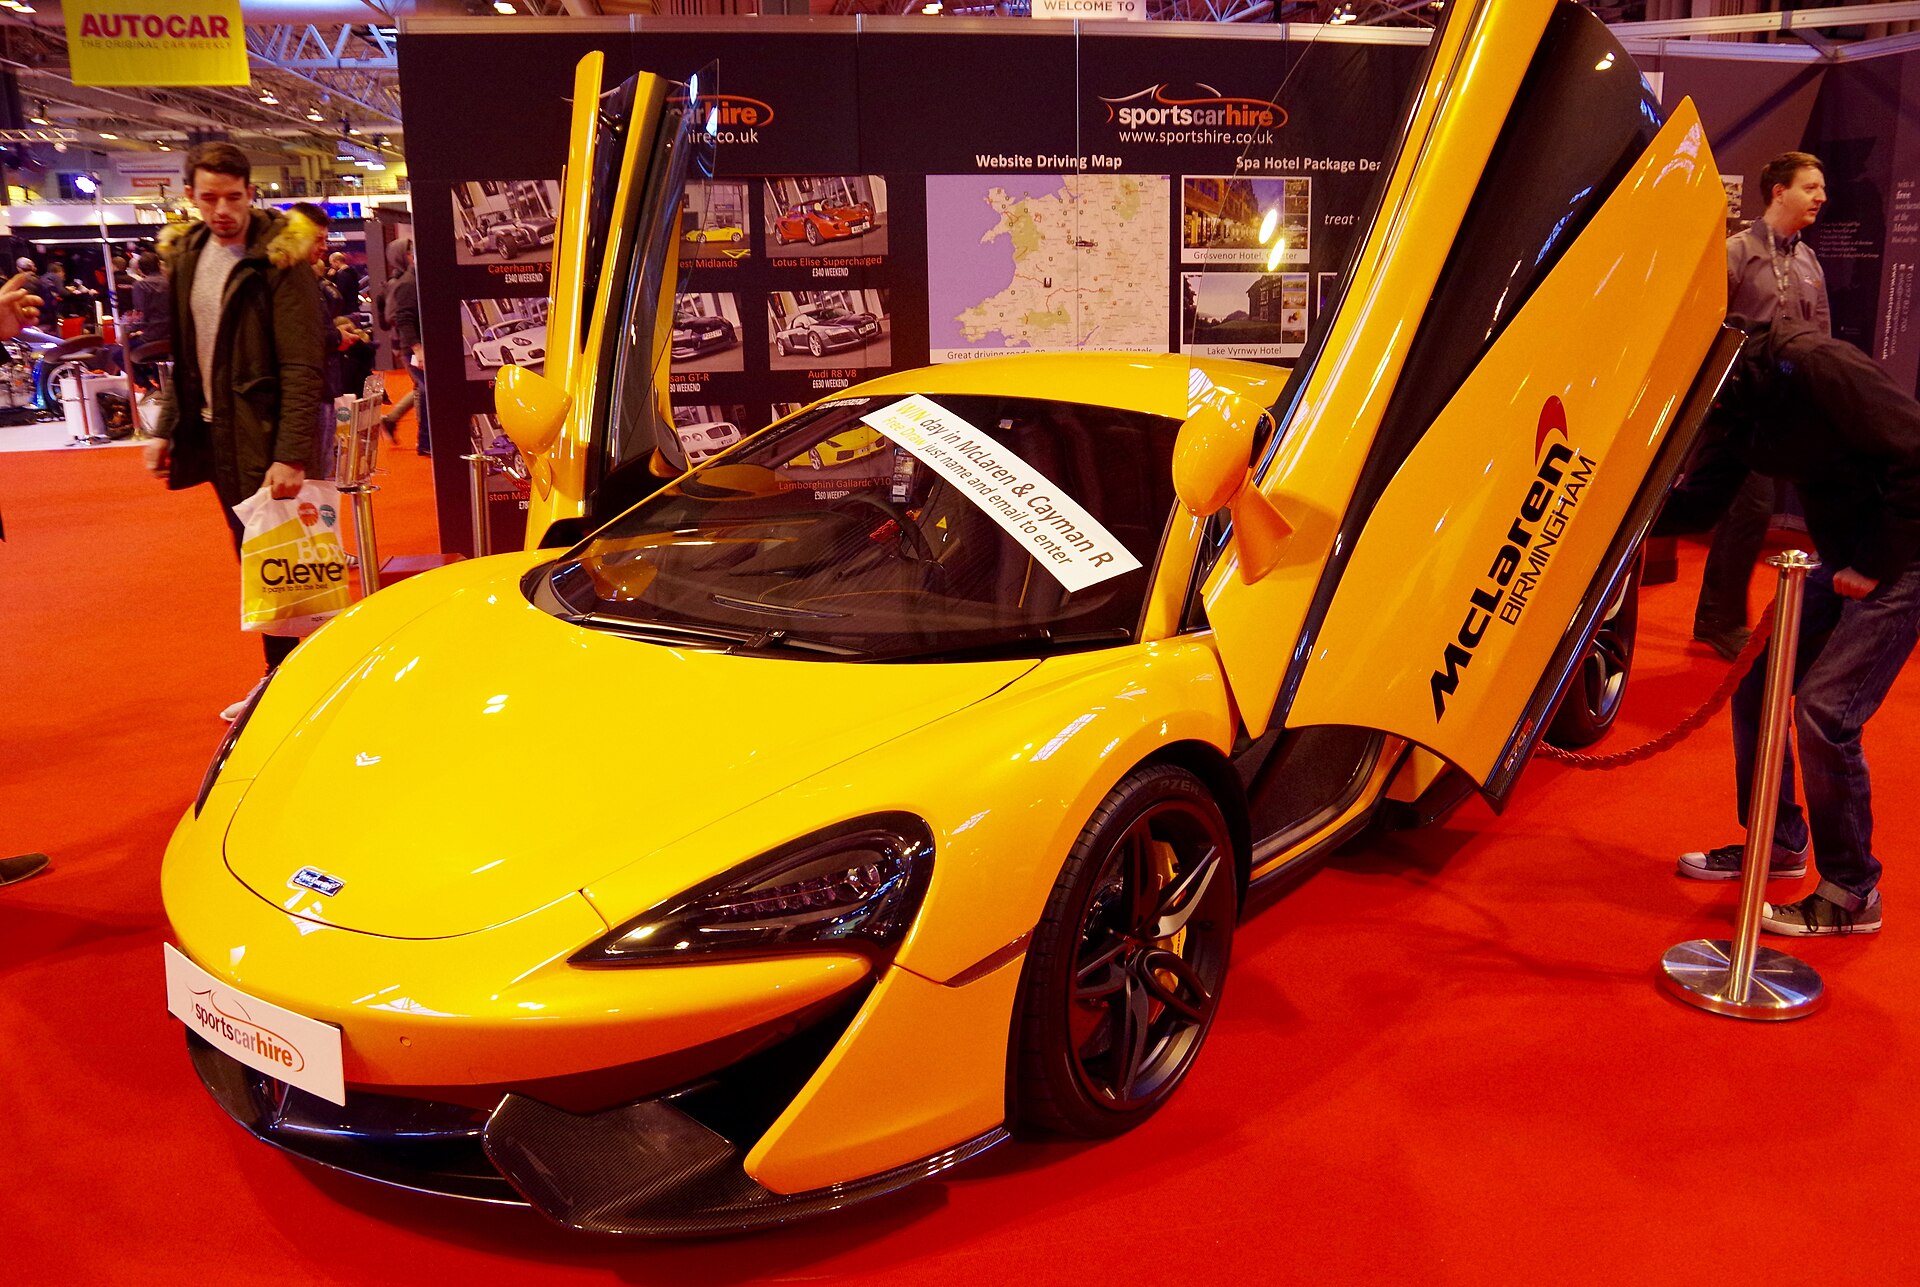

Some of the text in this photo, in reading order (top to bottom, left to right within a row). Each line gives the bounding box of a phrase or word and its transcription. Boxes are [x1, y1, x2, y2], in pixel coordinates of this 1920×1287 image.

[1044, 1, 1135, 11] WELCOME TO
[80, 13, 230, 38] AUTOCAR
[80, 40, 101, 48] THE
[105, 40, 159, 48] ORIGINAL
[1119, 104, 1274, 129] sportscarhire
[1119, 129, 1274, 146] www.sportshire.co.uk
[975, 154, 1122, 170] Website Driving Map
[1236, 156, 1260, 171] Spa
[1264, 156, 1300, 169] Hotel
[1304, 158, 1356, 173] Package
[1324, 214, 1354, 225] treat
[1193, 251, 1237, 260] Grosvenor
[695, 259, 738, 268] Midlands
[773, 258, 798, 268] Lotus
[800, 257, 821, 267] Elise
[487, 263, 534, 274] Caterham
[537, 263, 543, 272] 7
[825, 267, 849, 277] WEEKEND
[518, 273, 544, 283] WEEKEND
[947, 351, 972, 360] Great
[1207, 346, 1282, 358] Lake Vyrnwy Hotel
[688, 373, 710, 382] GT-R
[808, 369, 857, 379] Audi R8 V8
[676, 383, 701, 393] WEEKEND
[825, 379, 849, 388] WEEKEND
[778, 480, 834, 491] Lamborghini
[873, 477, 891, 486] V10
[896, 402, 1114, 568] WIN day in McLaren & Cayman R
[900, 427, 926, 446] Draw
[919, 442, 946, 459] just
[940, 453, 973, 480] name
[967, 476, 994, 497] and
[988, 494, 1029, 524] email
[1019, 517, 1038, 535] to
[1033, 535, 1074, 567] enter
[1498, 455, 1597, 626] BIRMINGHAM
[1430, 442, 1575, 725] McLaren
[195, 1001, 293, 1068] sportscarhire
